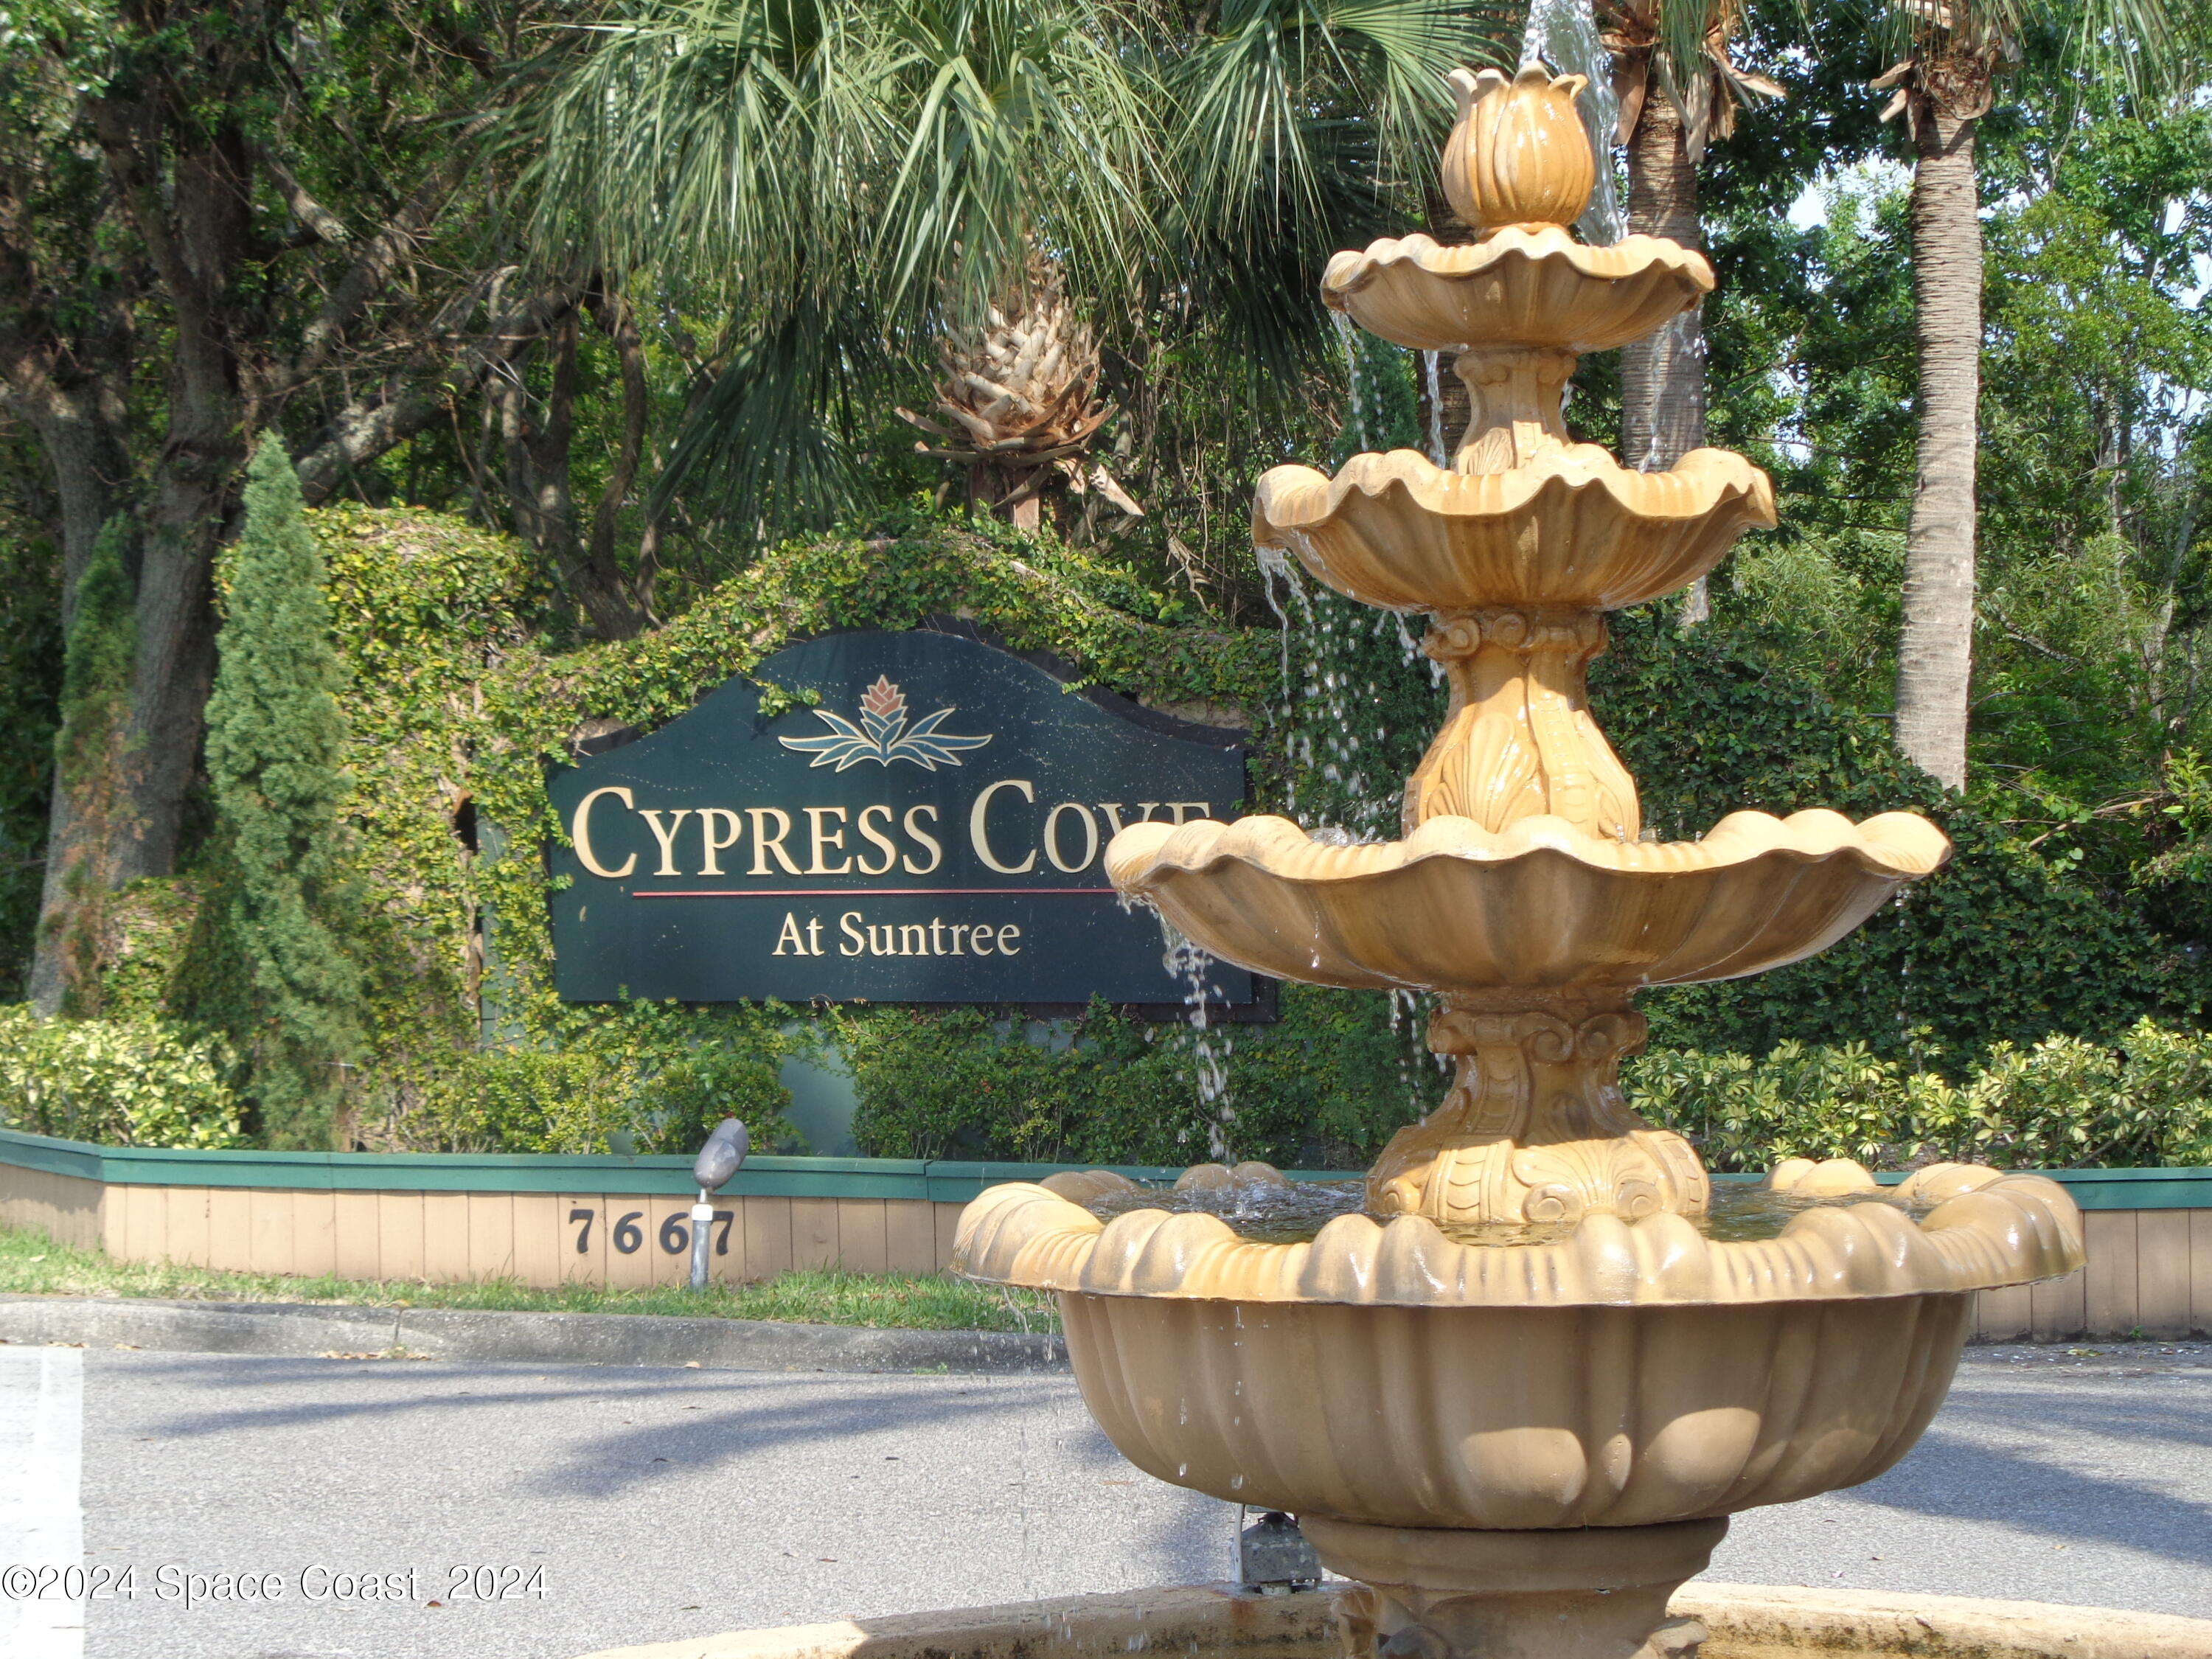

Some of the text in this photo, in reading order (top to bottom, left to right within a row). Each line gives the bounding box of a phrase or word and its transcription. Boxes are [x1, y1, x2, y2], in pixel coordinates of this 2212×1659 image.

[572, 786, 942, 877] CYPRESS
[772, 912, 1020, 957] At Suntree
[568, 1208, 734, 1256] 7667
